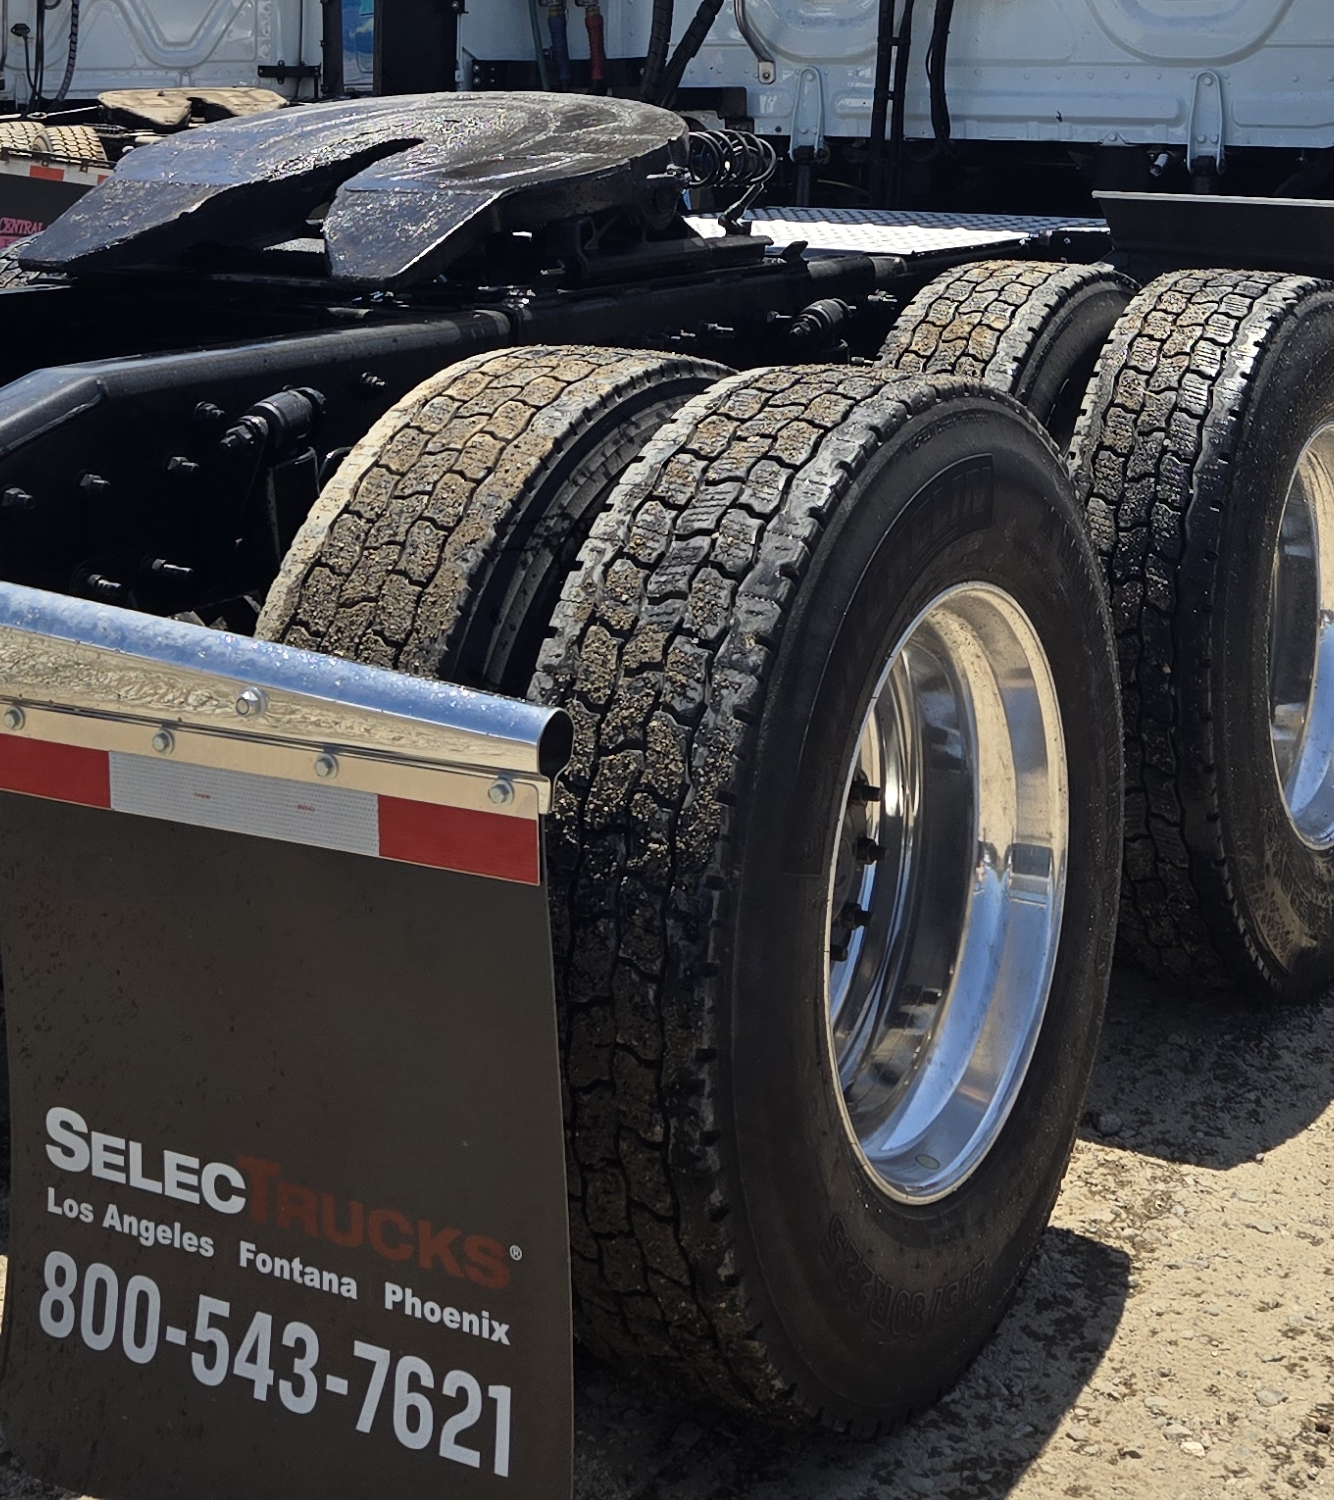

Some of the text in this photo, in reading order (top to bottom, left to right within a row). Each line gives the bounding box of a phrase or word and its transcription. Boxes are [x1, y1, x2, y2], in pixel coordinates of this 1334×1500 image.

[47, 1187, 510, 1346] Los Angeles Fontana Phoenix
[38, 1250, 512, 1478] 800-543-7621
